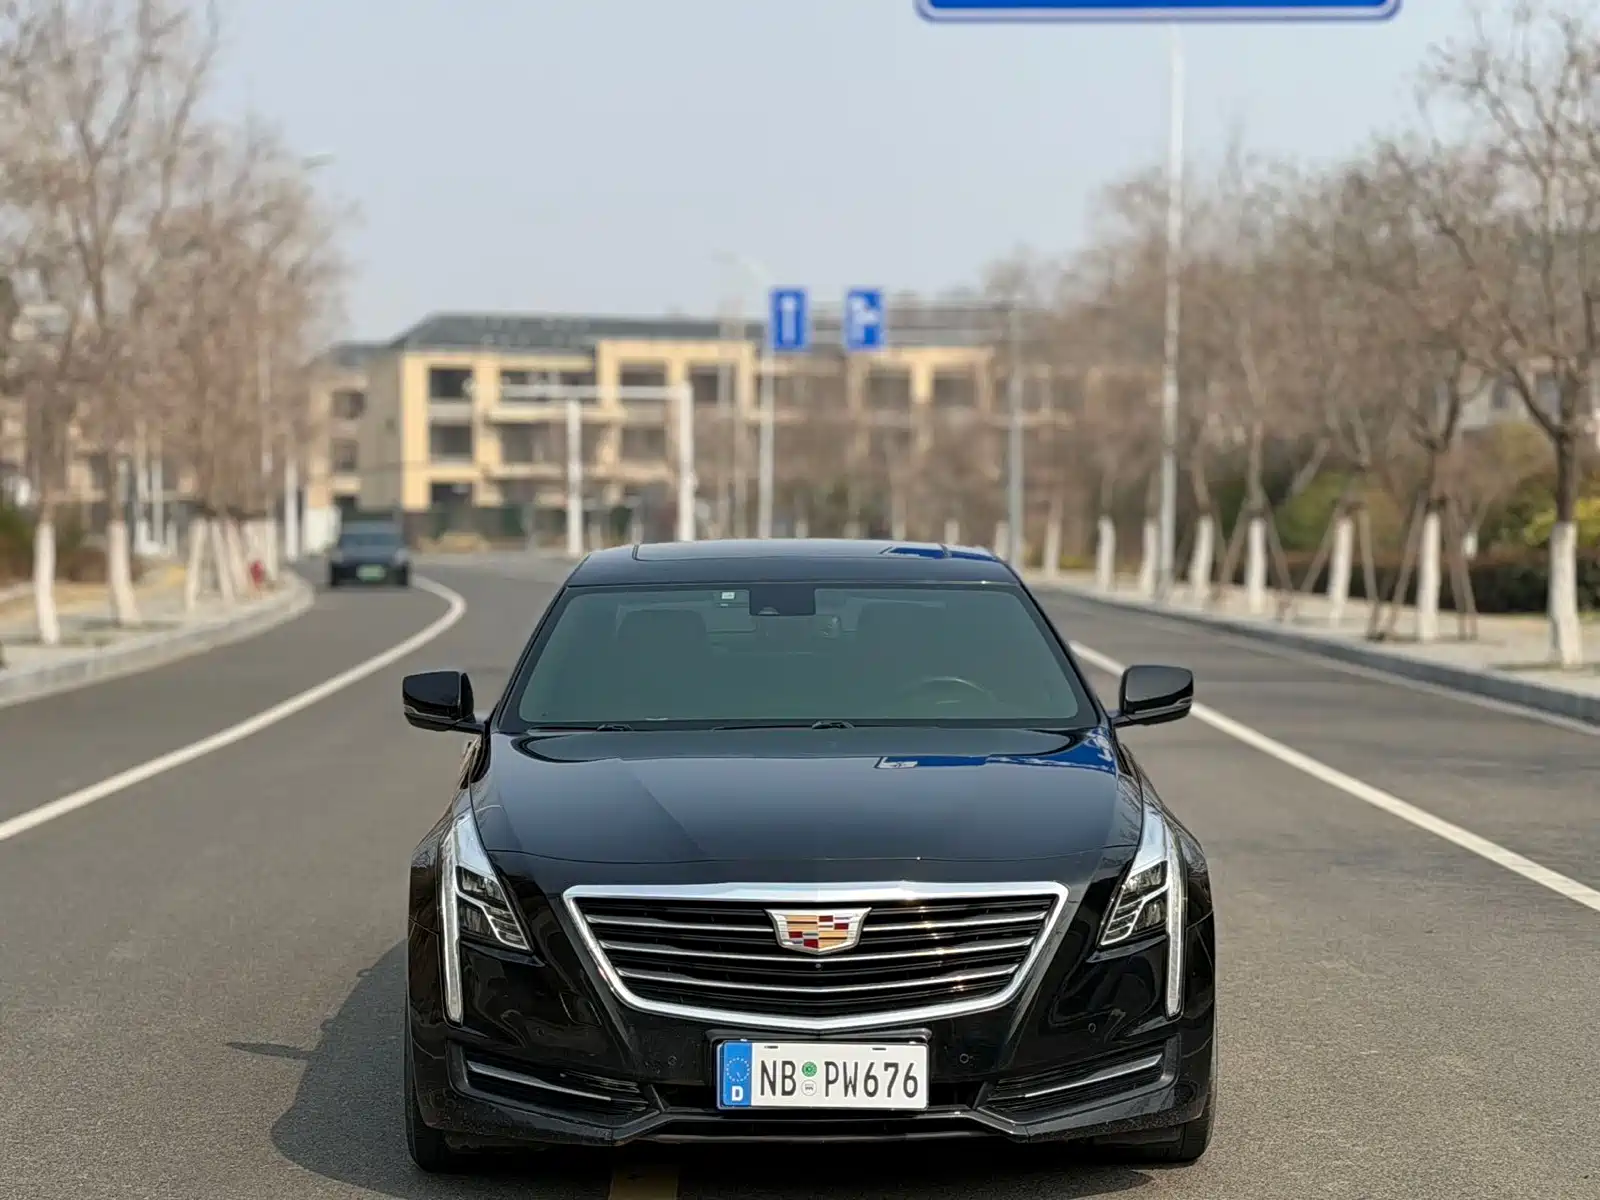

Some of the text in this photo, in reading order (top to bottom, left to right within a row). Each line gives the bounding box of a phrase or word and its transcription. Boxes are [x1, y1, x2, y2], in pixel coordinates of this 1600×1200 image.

[760, 1060, 918, 1098] NB PW676
[731, 1085, 744, 1101] D
